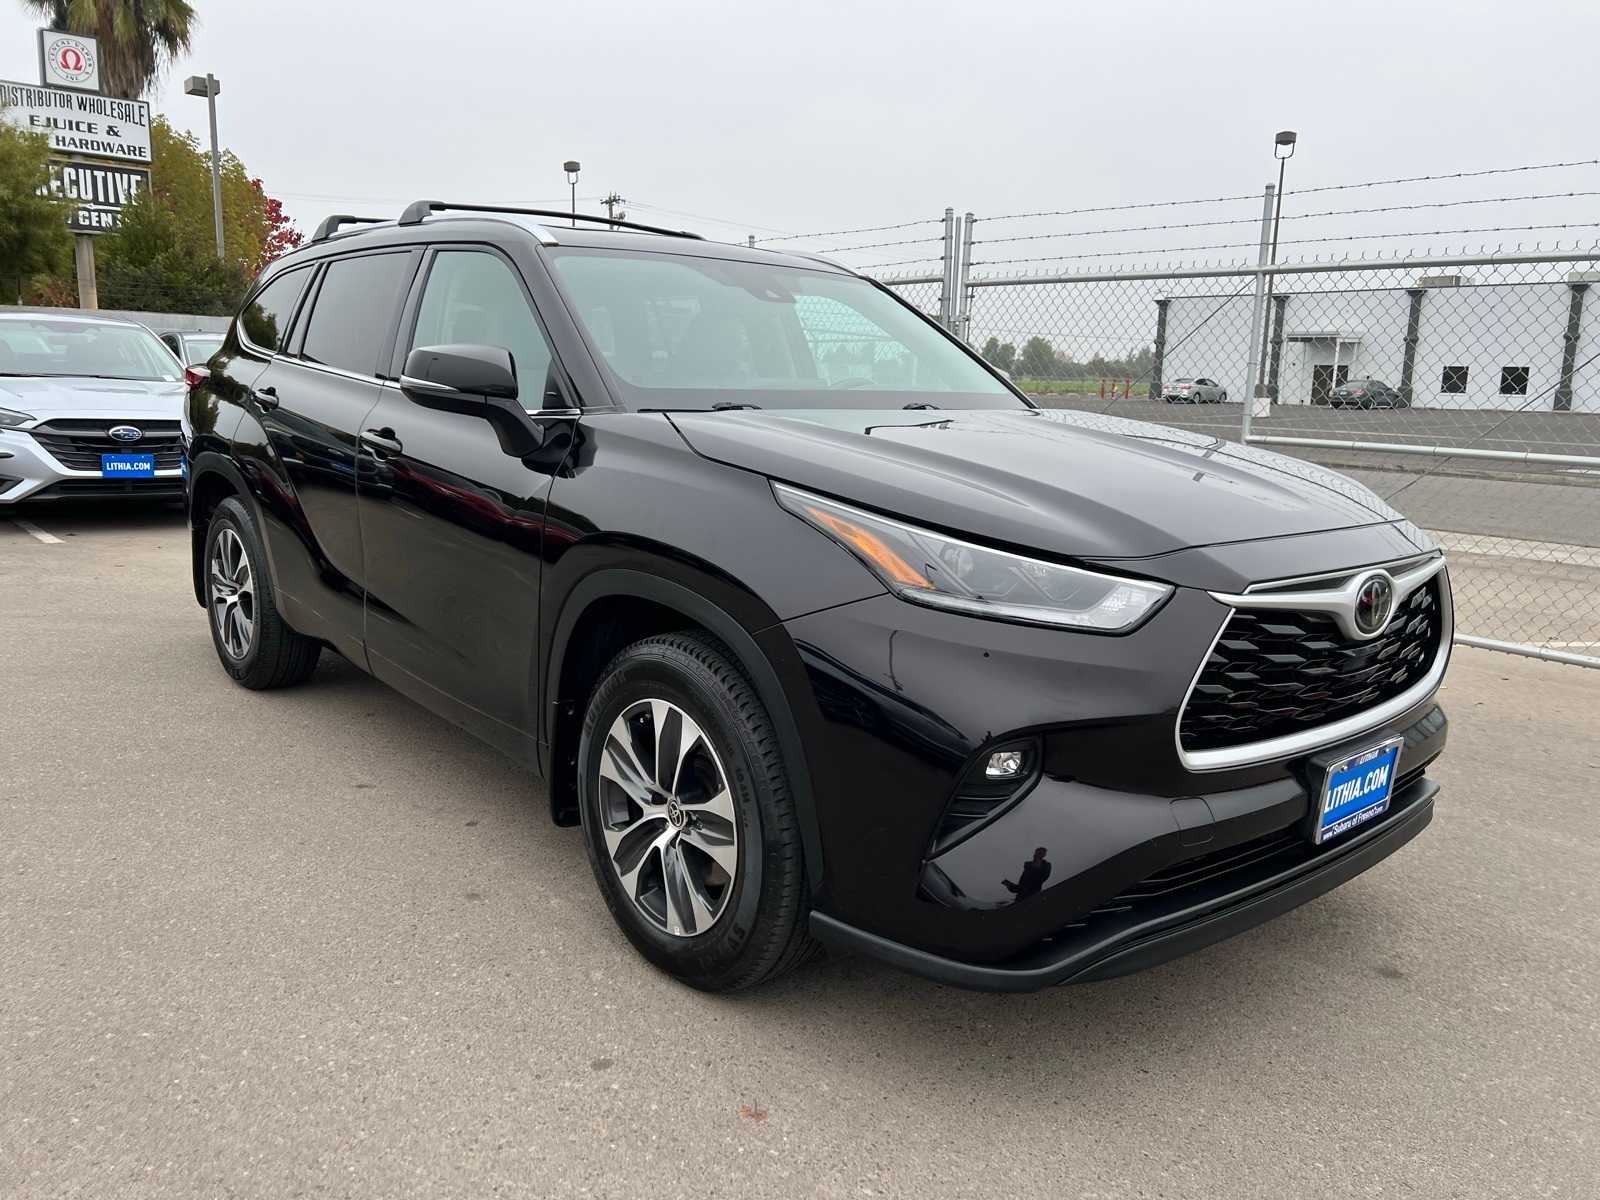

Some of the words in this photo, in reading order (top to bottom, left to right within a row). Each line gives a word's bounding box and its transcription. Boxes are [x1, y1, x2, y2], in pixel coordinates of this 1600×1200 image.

[0, 85, 73, 111] DISTRIBUTOR
[76, 95, 146, 127] WHOLESALE
[29, 115, 98, 134] EJUICE
[106, 125, 122, 138] &
[55, 135, 147, 158] HARDWARE
[106, 462, 151, 471] LITHIA.COM
[1323, 764, 1390, 814] LITHIA.COM
